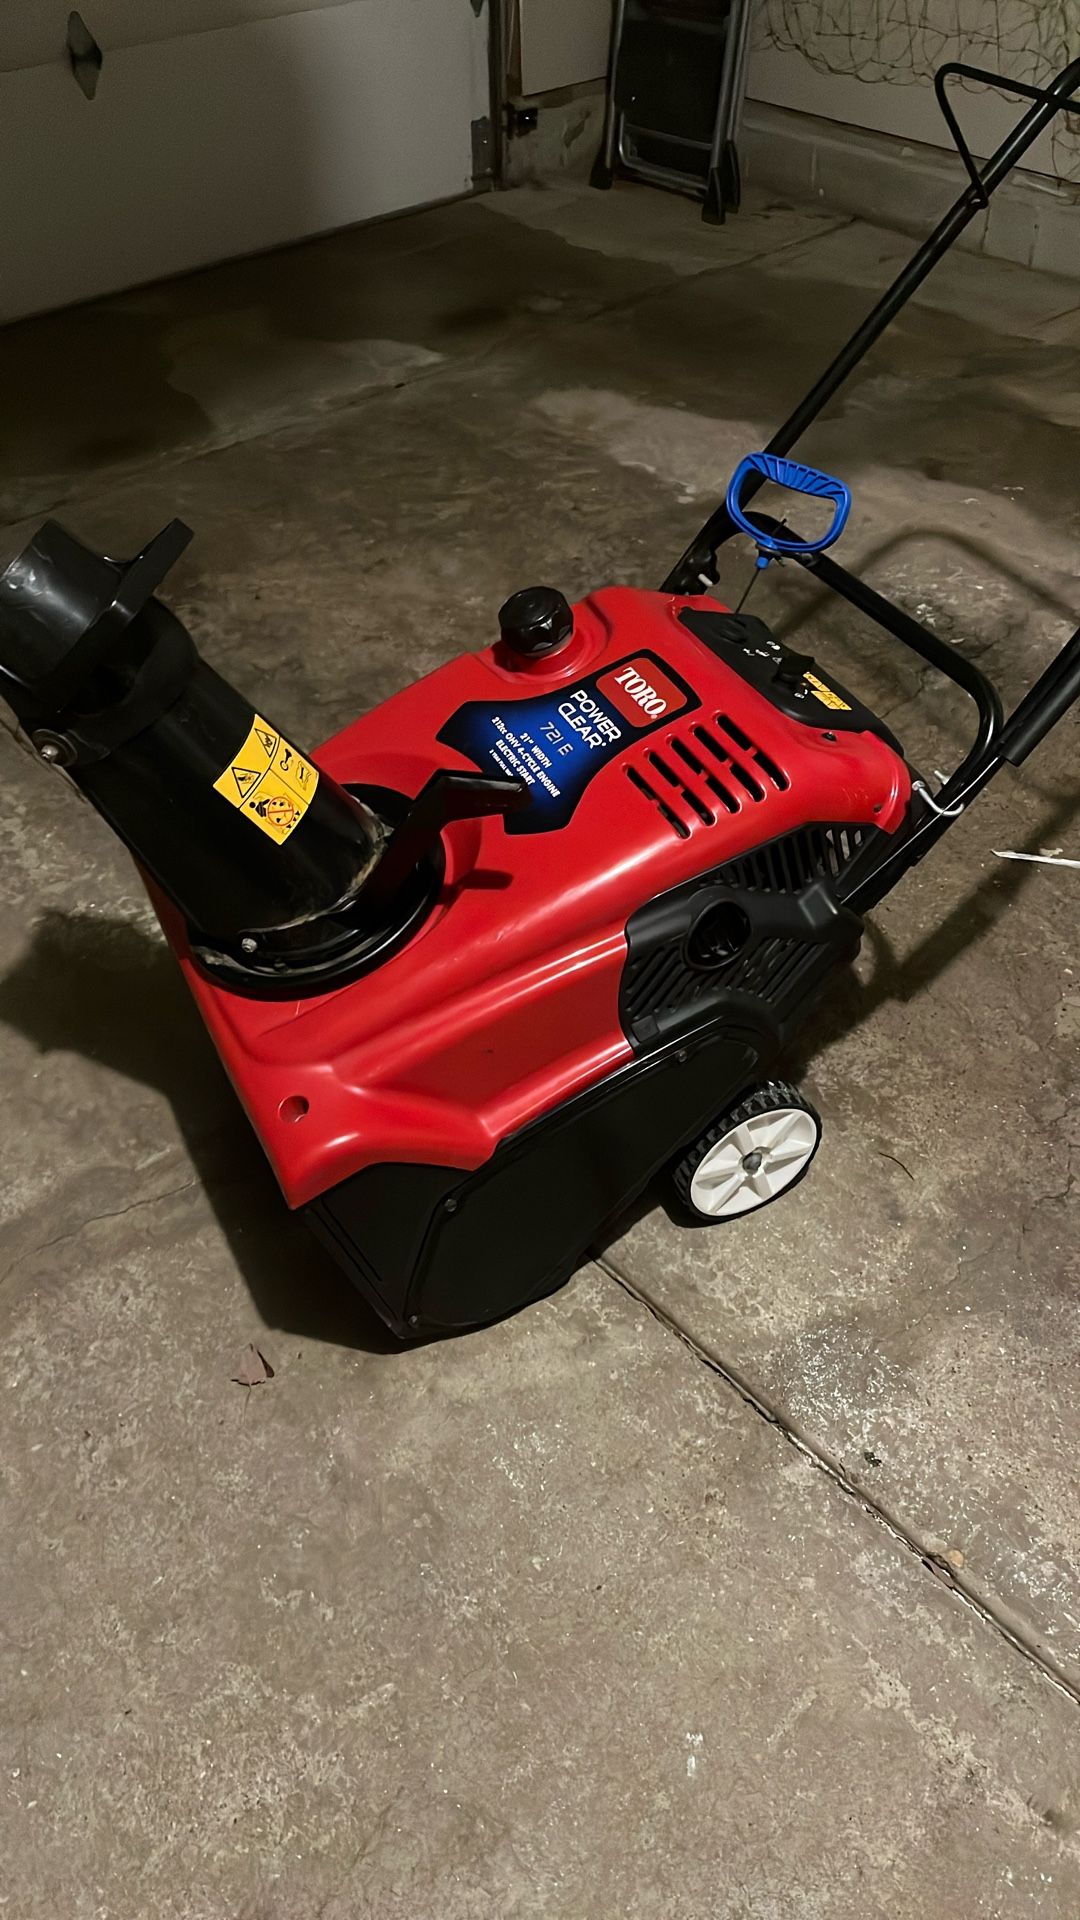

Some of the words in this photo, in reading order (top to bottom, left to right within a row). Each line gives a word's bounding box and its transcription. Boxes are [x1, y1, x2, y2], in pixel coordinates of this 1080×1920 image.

[614, 667, 667, 716] TORO
[540, 721, 564, 745] 721
[557, 743, 574, 756] E
[558, 702, 606, 749] CLEAR
[570, 690, 621, 742] POWER
[491, 716, 507, 734] 212cc
[505, 732, 521, 748] OHV
[517, 747, 541, 773] 4-CYCLE
[536, 771, 561, 798] ENGINE
[495, 739, 521, 768] ELECTRIC
[516, 765, 535, 786] START
[531, 745, 552, 768] WIDTH
